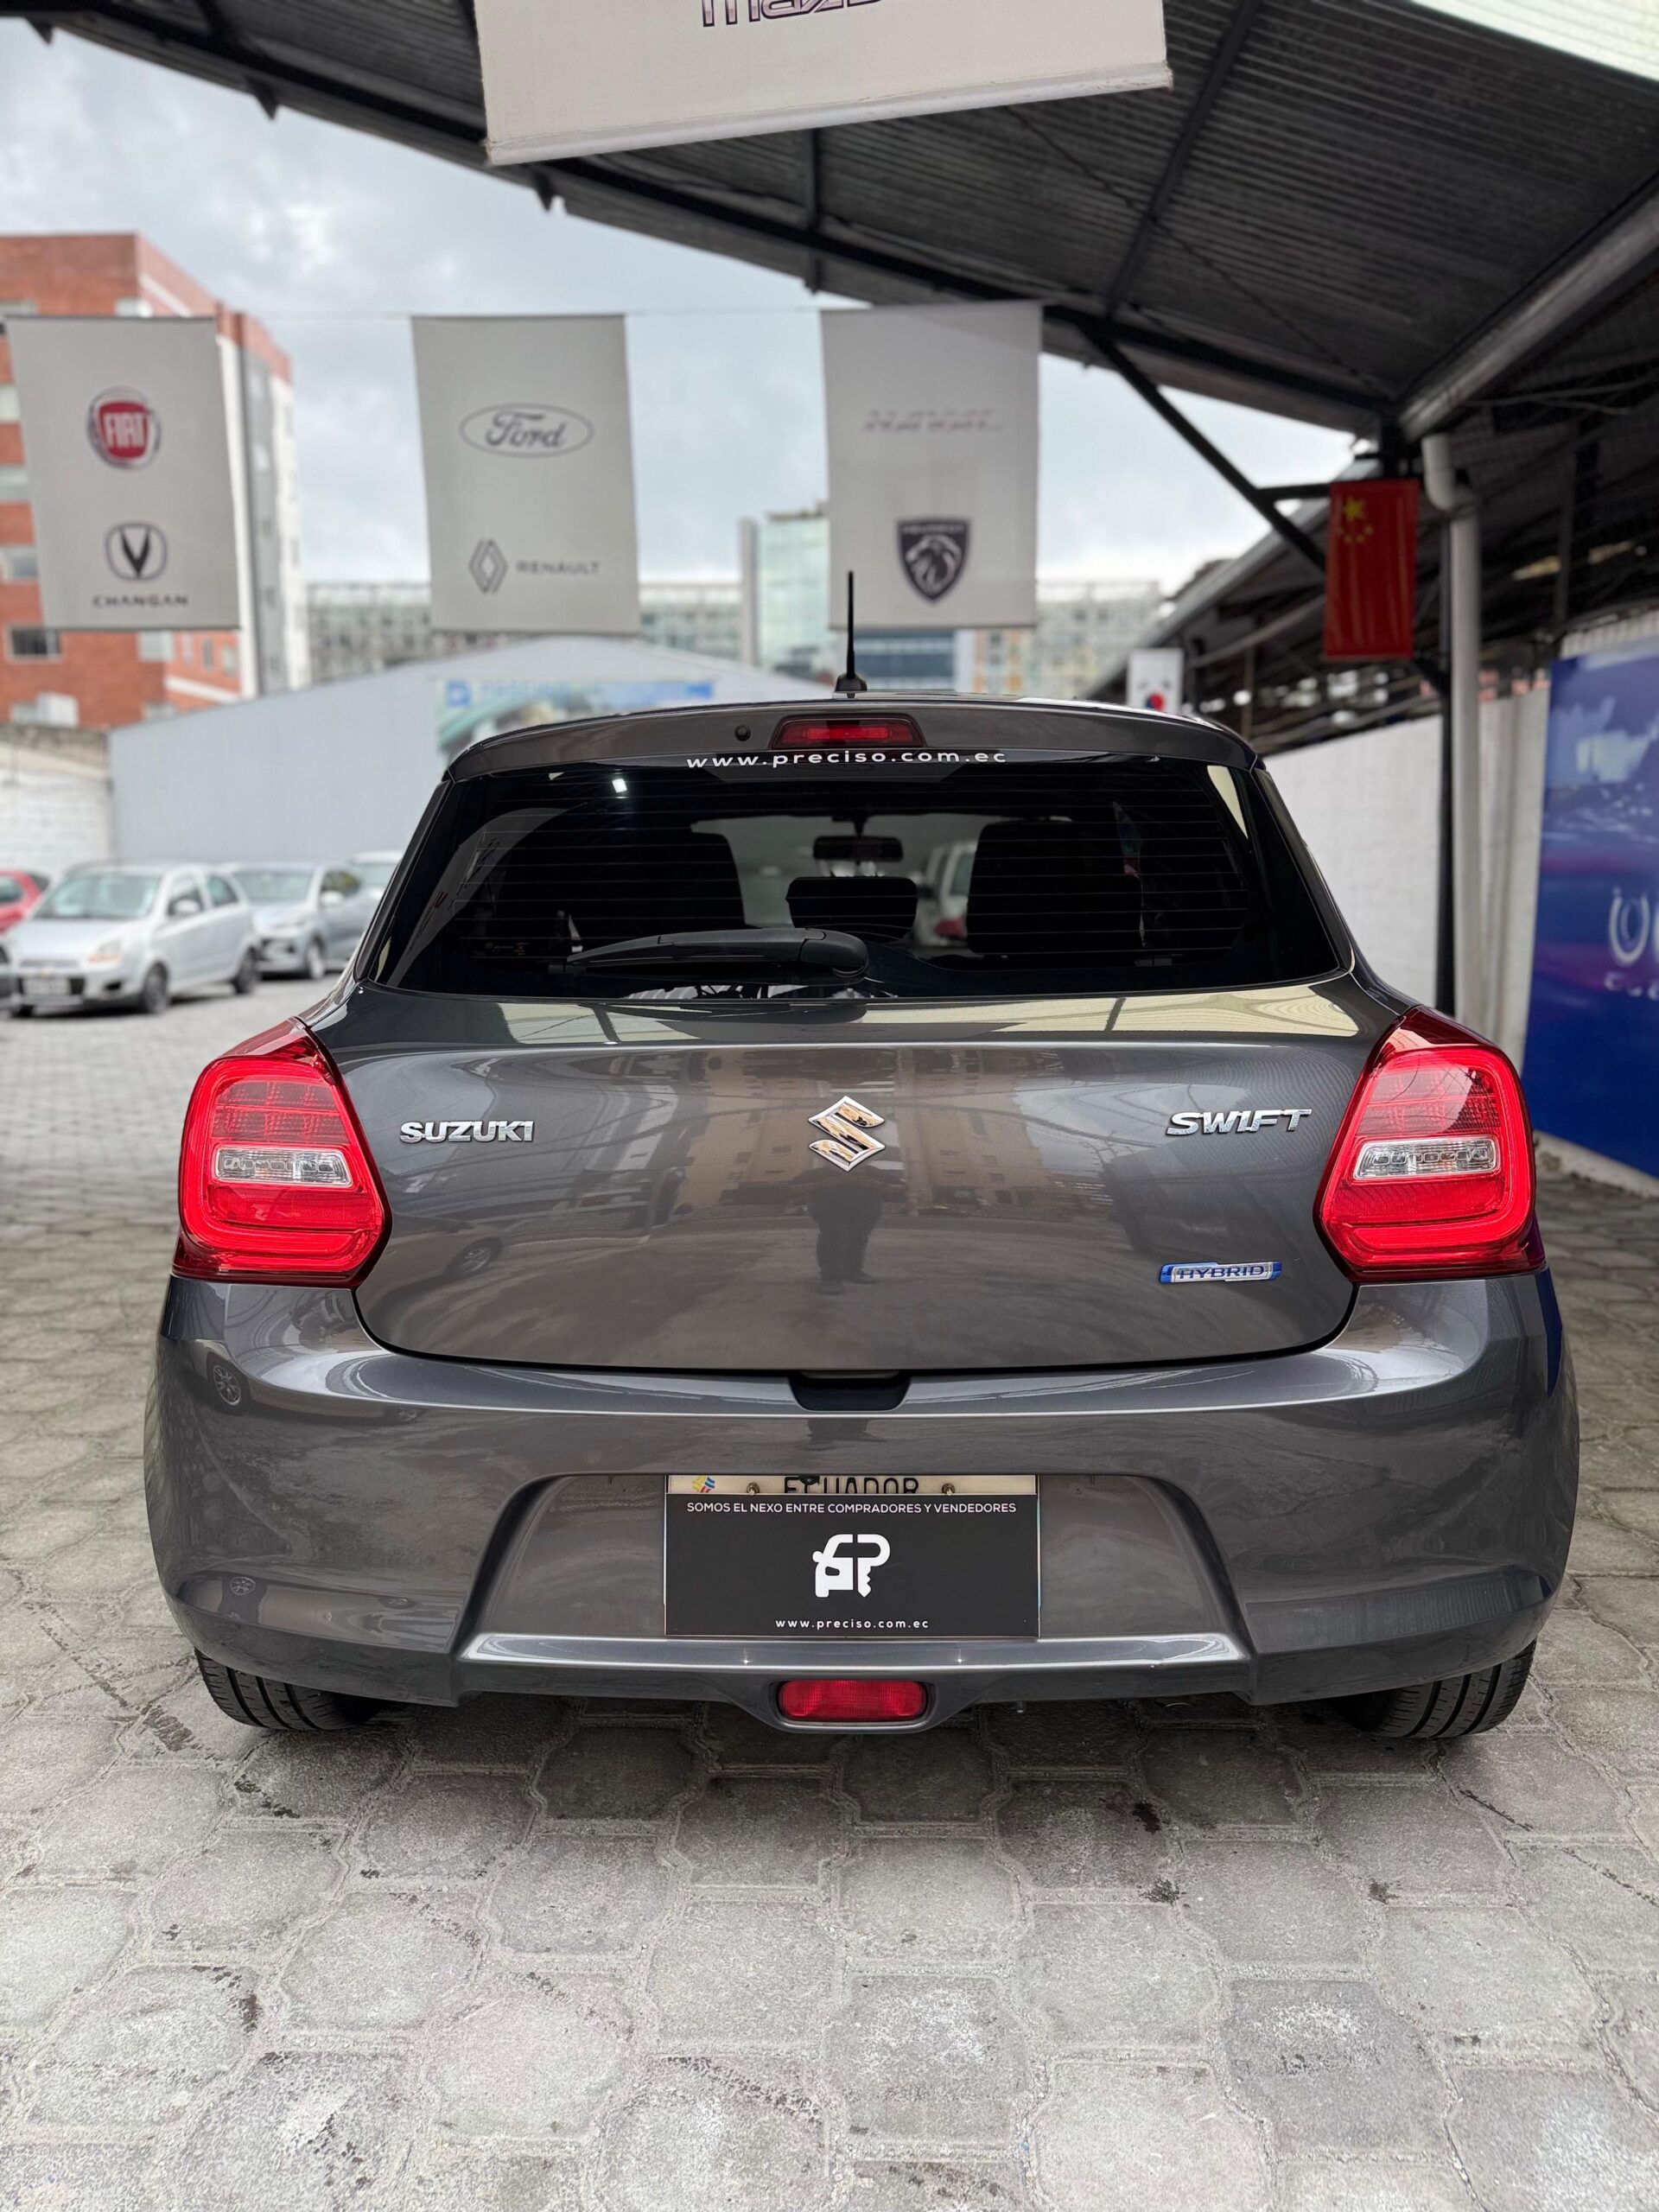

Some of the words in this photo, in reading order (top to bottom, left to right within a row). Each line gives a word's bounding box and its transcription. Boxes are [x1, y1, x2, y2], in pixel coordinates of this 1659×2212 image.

[104, 413, 148, 448] FIAT
[485, 410, 567, 448] Ford
[517, 561, 601, 575] RENAULT
[92, 594, 189, 607] CHANGAN
[687, 750, 1007, 768] www.preciso.com.ec
[1166, 1109, 1313, 1135] SWIFT
[399, 1121, 534, 1144] SUZUKI
[1179, 1265, 1264, 1280] HYBRID
[687, 1502, 731, 1512] SOMOS
[734, 1503, 747, 1512] EL
[750, 1503, 783, 1513] NEXO
[785, 1503, 825, 1513] ENTRE
[827, 1503, 922, 1514] COMPRADORES
[924, 1503, 932, 1513] Y
[933, 1503, 1017, 1513] VENDEDORES
[775, 1618, 929, 1630] www.preciso.com.ec
